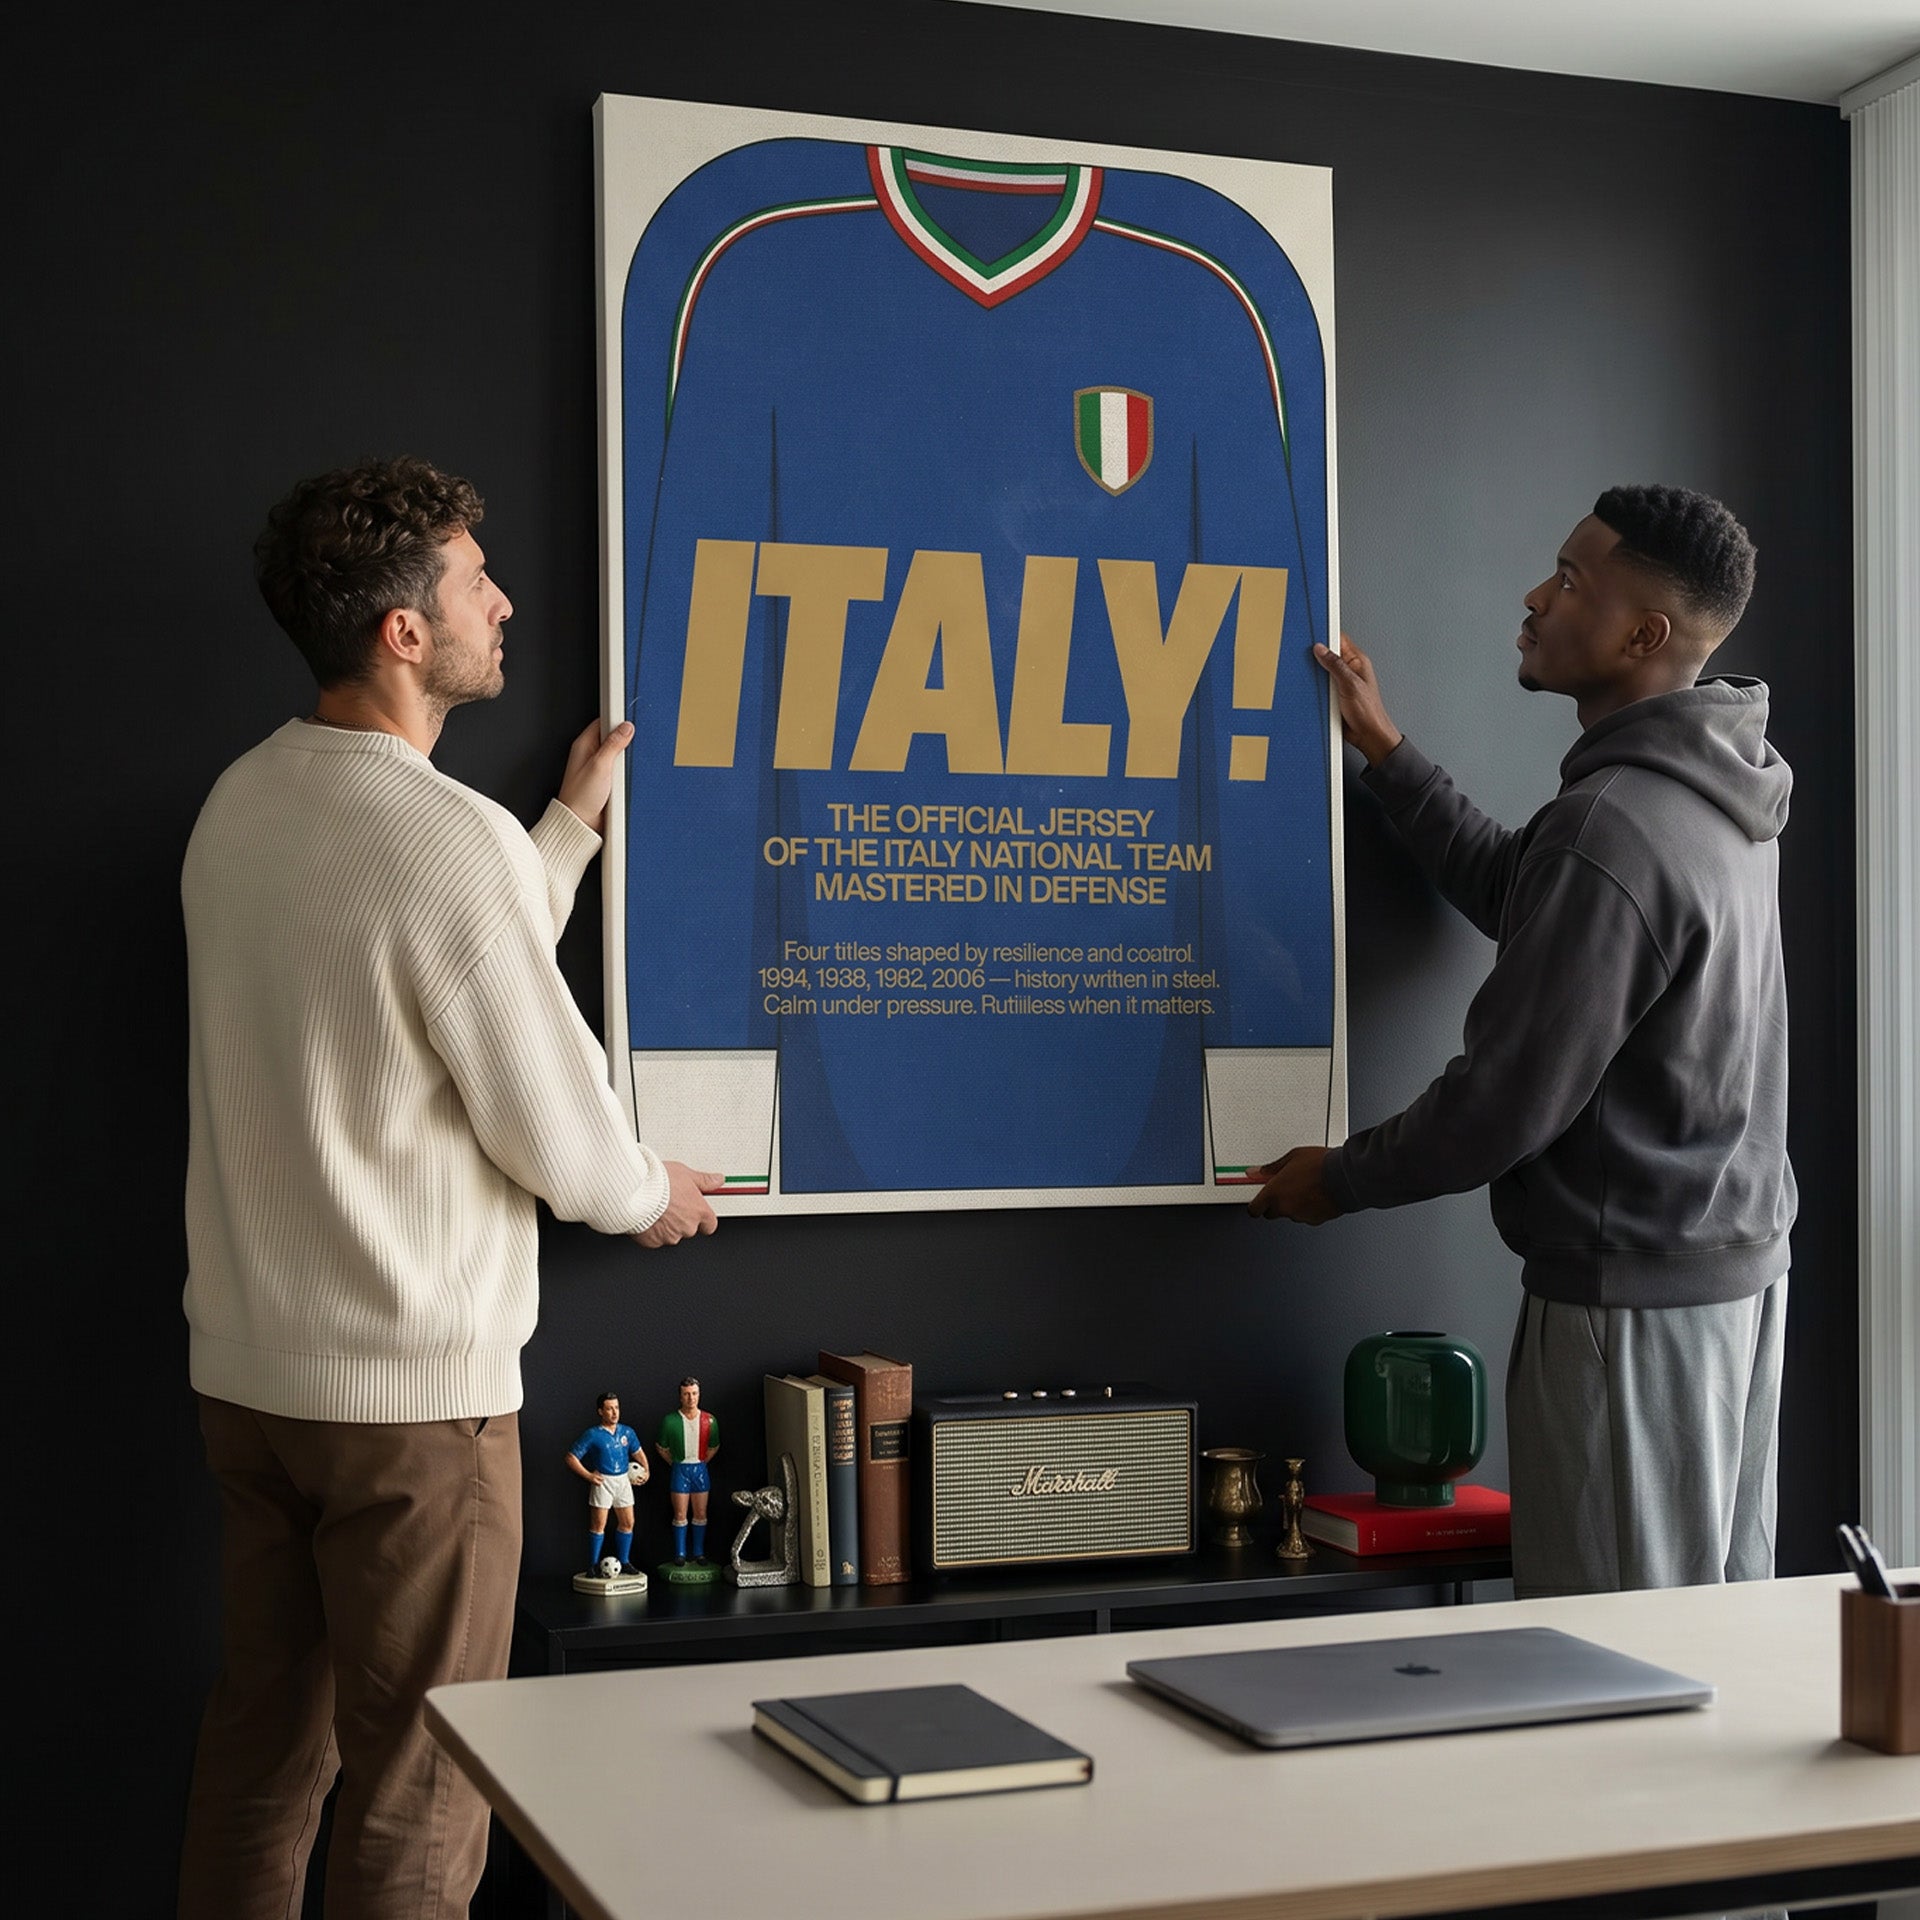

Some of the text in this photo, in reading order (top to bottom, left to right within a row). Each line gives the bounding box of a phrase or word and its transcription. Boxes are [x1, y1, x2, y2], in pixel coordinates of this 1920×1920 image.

[673, 538, 1289, 782] ITALY!
[827, 803, 1155, 838] THE OFFICIAL JERSEY
[763, 836, 1213, 872] OF THE ITALY NATIONAL TEAM
[815, 872, 1167, 905] MASTERED IN DEFENSE
[784, 940, 830, 962] Four
[834, 941, 882, 963] titles
[886, 942, 960, 966] shaped
[965, 943, 989, 968] by
[993, 942, 1084, 963] resilience
[1087, 943, 1123, 963] and
[758, 967, 812, 992] 1994,
[816, 967, 871, 992] 1938,
[875, 968, 927, 991] 1982,
[932, 968, 985, 989] 2006
[1014, 969, 1079, 994] history
[1151, 970, 1168, 989] in
[1172, 970, 1220, 989] steel.
[763, 993, 818, 1016] Calm
[822, 995, 882, 1015] under
[887, 998, 978, 1019] pressure.
[1069, 996, 1121, 1015] when
[1126, 995, 1138, 1014] it
[1141, 996, 1216, 1014] matters.
[1011, 1466, 1119, 1495] Marshall
